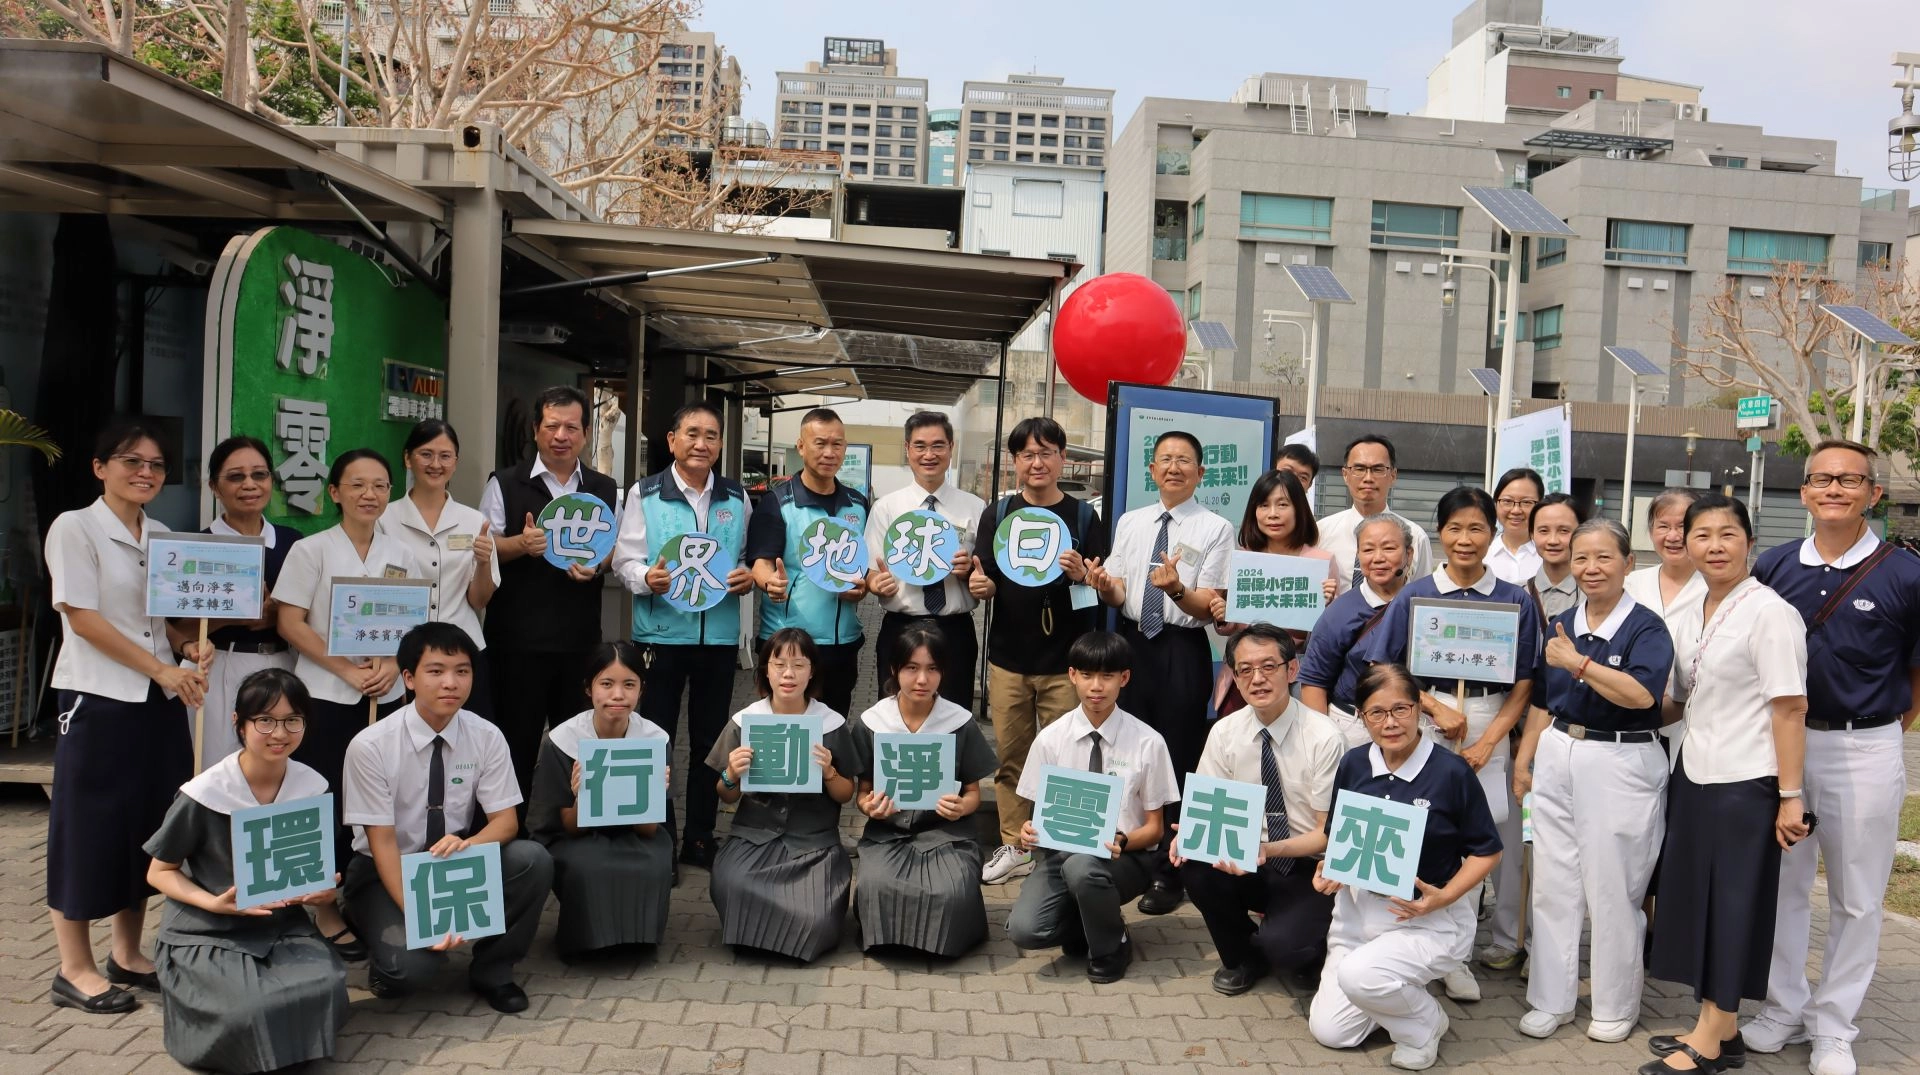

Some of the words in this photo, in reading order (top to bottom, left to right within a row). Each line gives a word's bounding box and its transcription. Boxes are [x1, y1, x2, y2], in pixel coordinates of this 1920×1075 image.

[277, 253, 335, 514] 淨零
[1530, 438, 1545, 478] 淨零
[167, 551, 177, 566] 2
[542, 505, 612, 560] 世
[802, 521, 864, 583] 地
[887, 517, 950, 577] 球
[1008, 514, 1062, 573] 日
[176, 580, 235, 595] 邁向淨零
[670, 535, 727, 607] 界
[1236, 576, 1309, 592] 環保小行動
[1236, 592, 1318, 609] 淨零大未來!!
[1237, 568, 1263, 577] 2024
[176, 597, 234, 612] 淨零轉型
[347, 595, 357, 609] 5
[1429, 617, 1439, 631] 3
[355, 629, 404, 642] 淨零賓果
[1430, 650, 1497, 668] 淨零小學堂
[585, 748, 653, 818] 行
[748, 723, 810, 787] 動
[880, 741, 944, 803] 淨
[1041, 774, 1112, 848] 零
[1182, 787, 1249, 861] 未
[243, 807, 325, 897] 環
[1329, 803, 1410, 887] 來
[410, 855, 491, 940] 保
